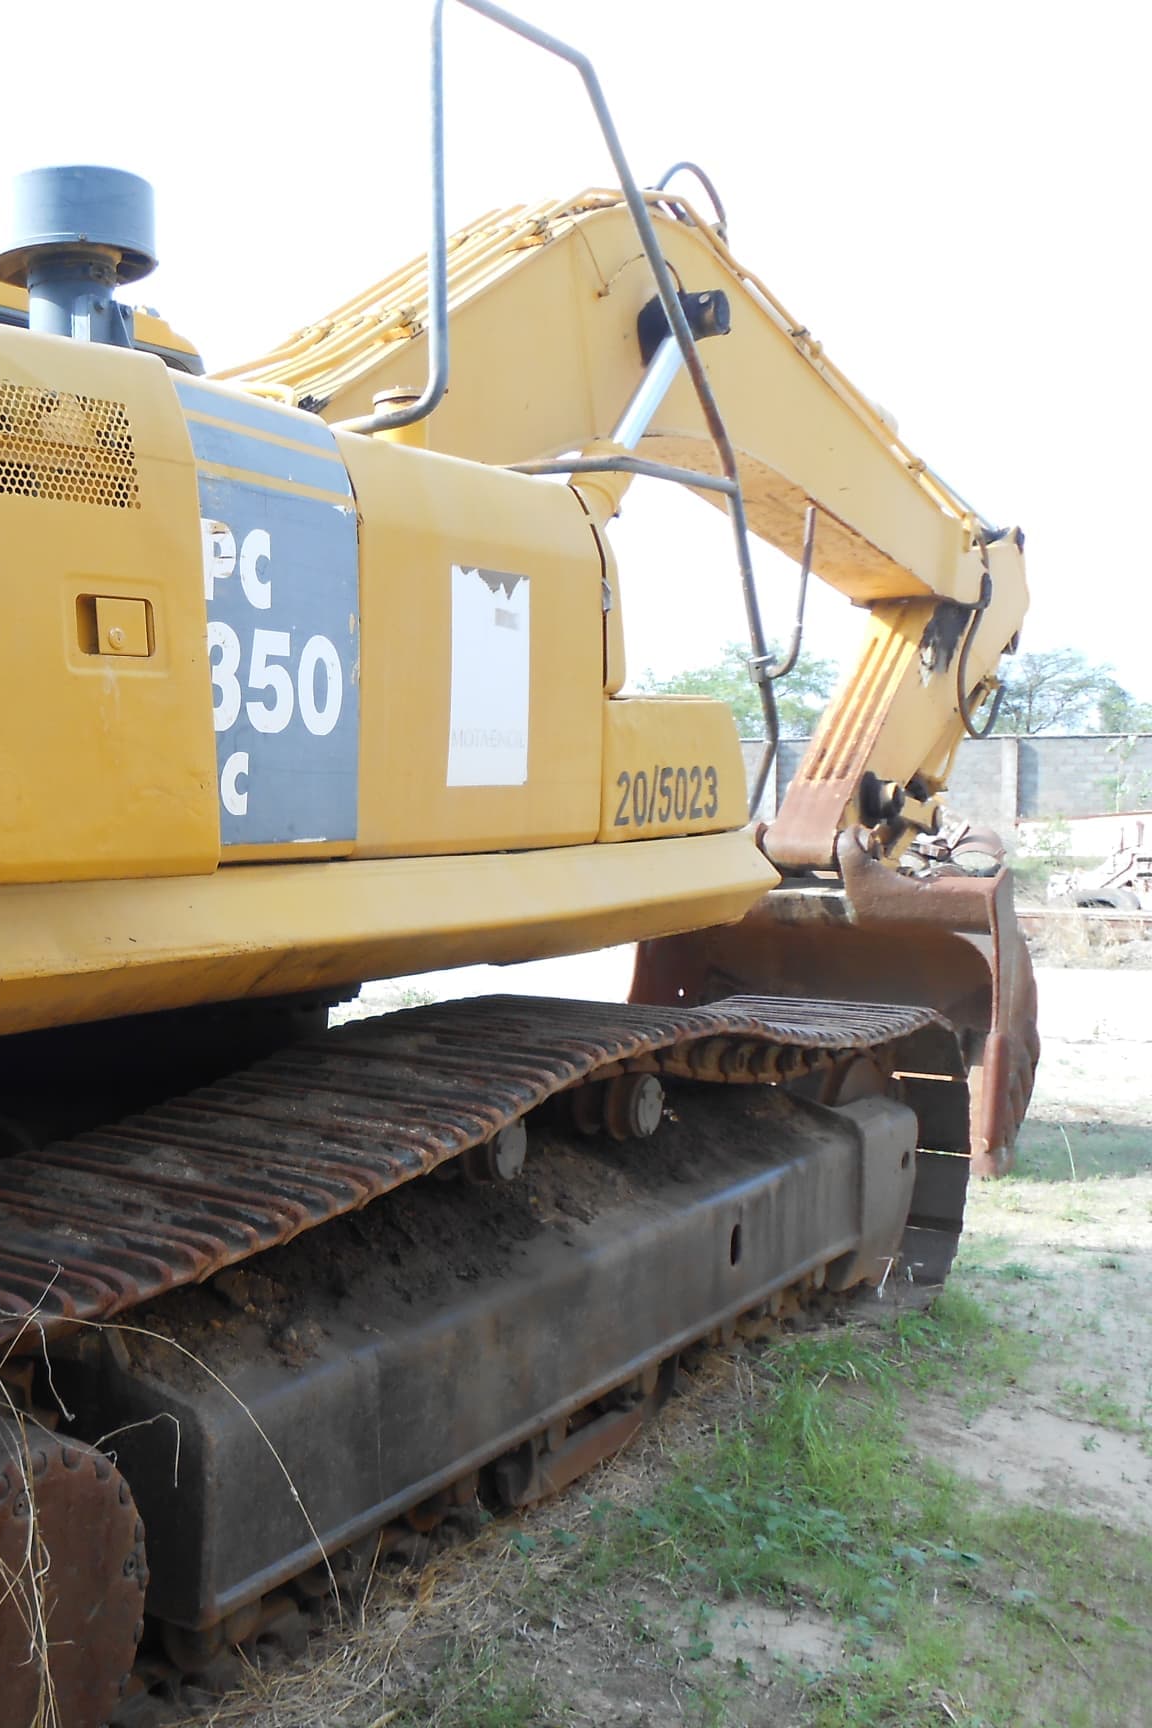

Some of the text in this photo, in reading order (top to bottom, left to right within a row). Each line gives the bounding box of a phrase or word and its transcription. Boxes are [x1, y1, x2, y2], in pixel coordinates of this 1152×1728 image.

[200, 518, 271, 609] PC
[207, 621, 342, 735] 350
[614, 765, 718, 826] 20/5023
